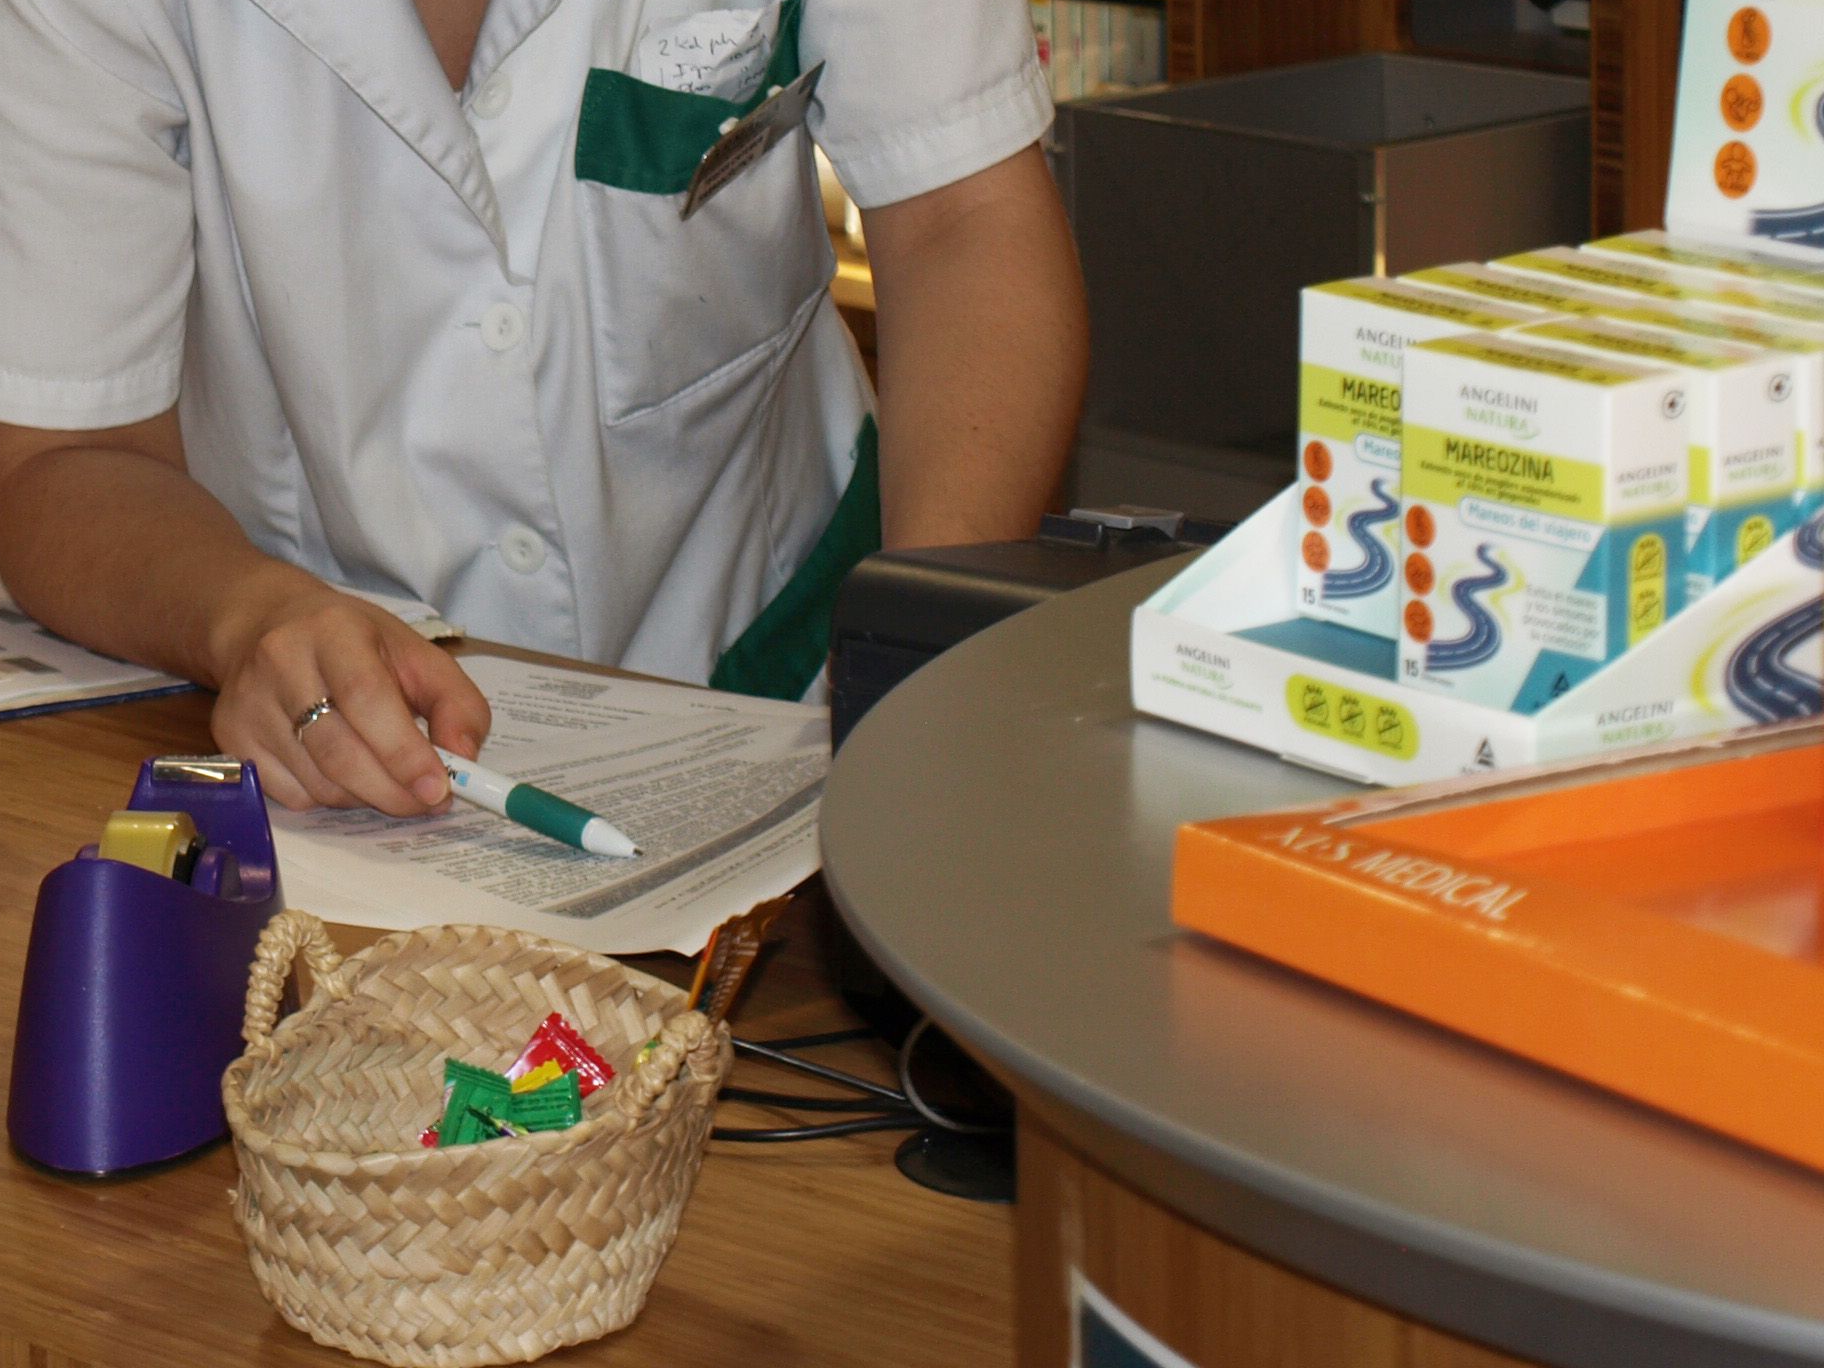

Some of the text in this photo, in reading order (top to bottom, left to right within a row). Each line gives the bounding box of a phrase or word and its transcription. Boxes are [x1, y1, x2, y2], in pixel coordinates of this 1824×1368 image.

[1460, 385, 1539, 414] ANGELINI
[1465, 406, 1529, 431] NATURA
[1445, 437, 1555, 484] MAREOZINA
[1469, 501, 1516, 526] Mareos
[1519, 514, 1540, 531] del
[1302, 587, 1316, 605] 15
[1176, 643, 1231, 670] ANGELINI
[1404, 658, 1419, 678] 15
[1597, 700, 1675, 727] ANGELINI
[1351, 850, 1529, 922] MEDICAL
